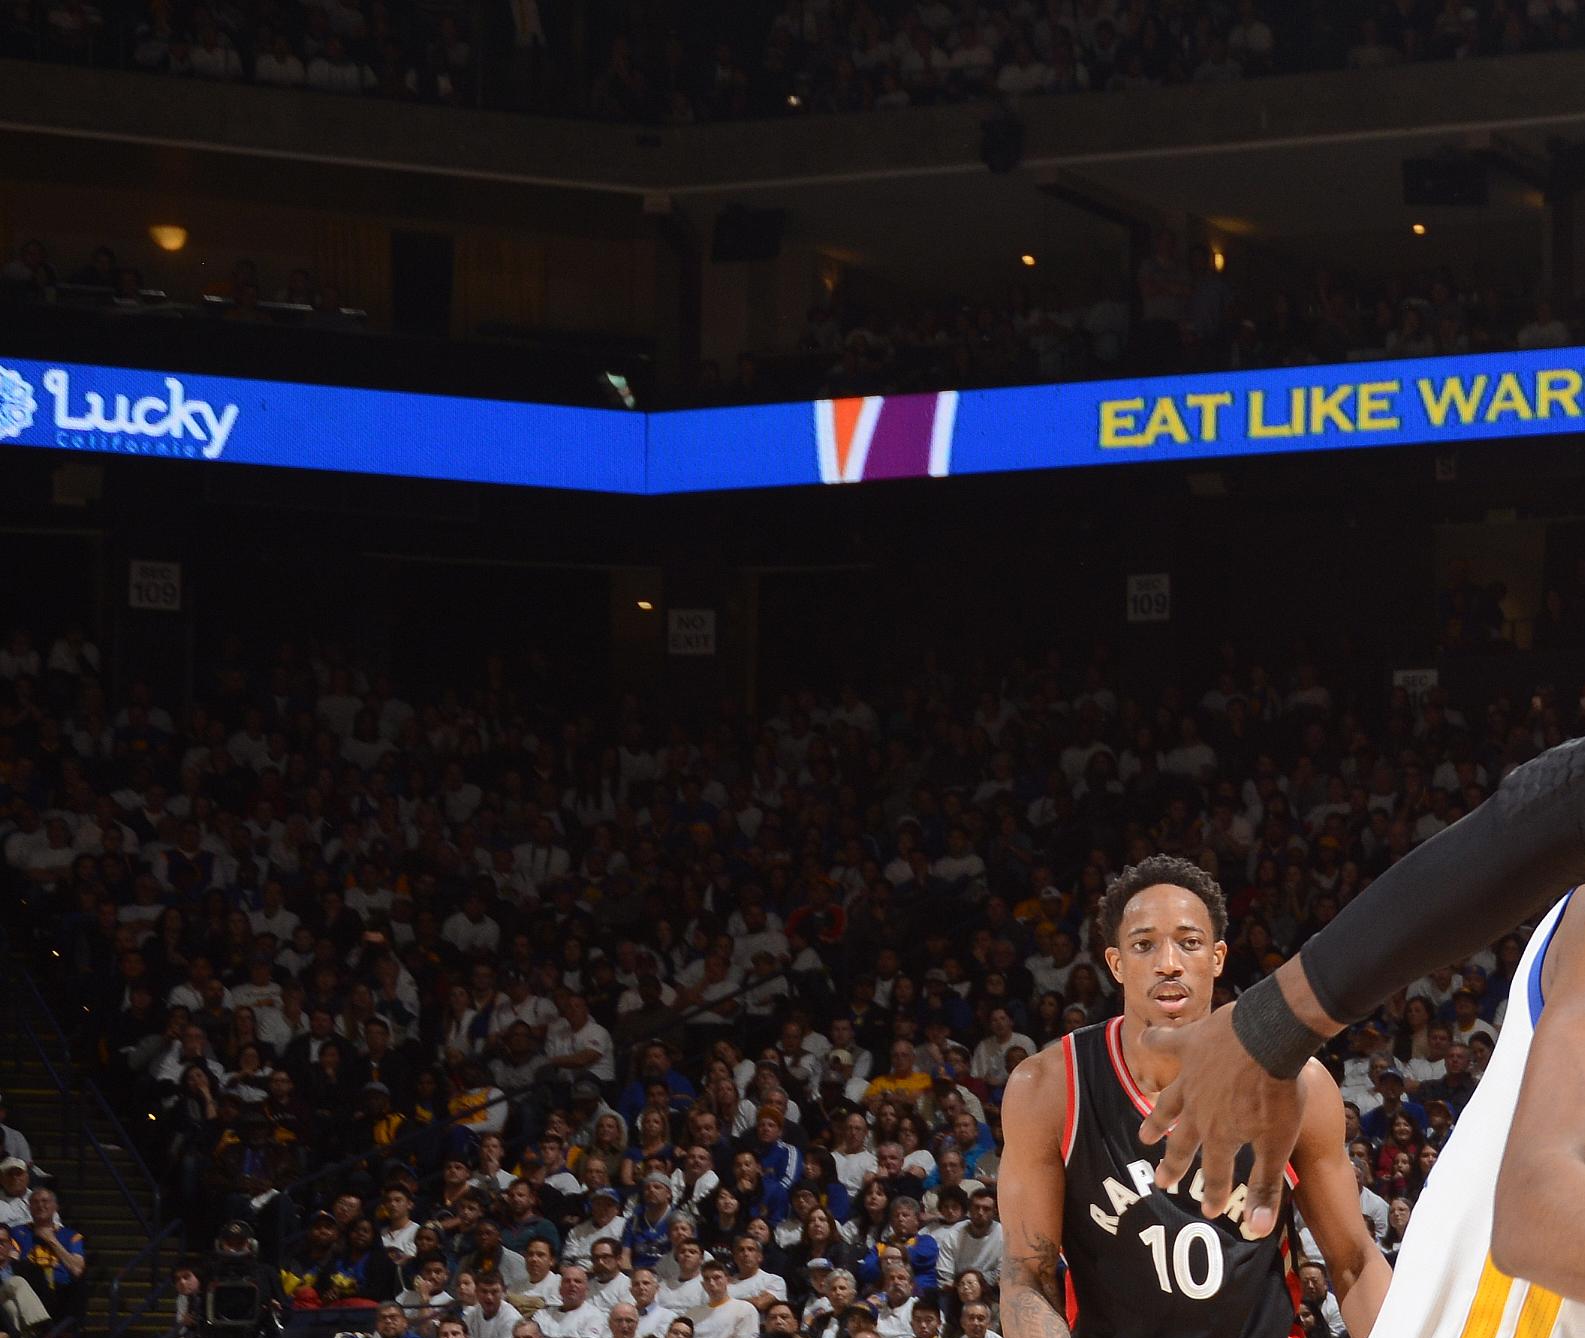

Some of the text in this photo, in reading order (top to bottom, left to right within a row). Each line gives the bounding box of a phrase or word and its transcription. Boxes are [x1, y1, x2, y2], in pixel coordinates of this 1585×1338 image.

[42, 368, 240, 459] Lucky
[1100, 394, 1231, 447] EAT
[1247, 381, 1400, 438] LIKE
[133, 581, 177, 604] 109
[1131, 592, 1168, 614] 109
[677, 615, 706, 630] NO
[1138, 1221, 1224, 1300] 10
